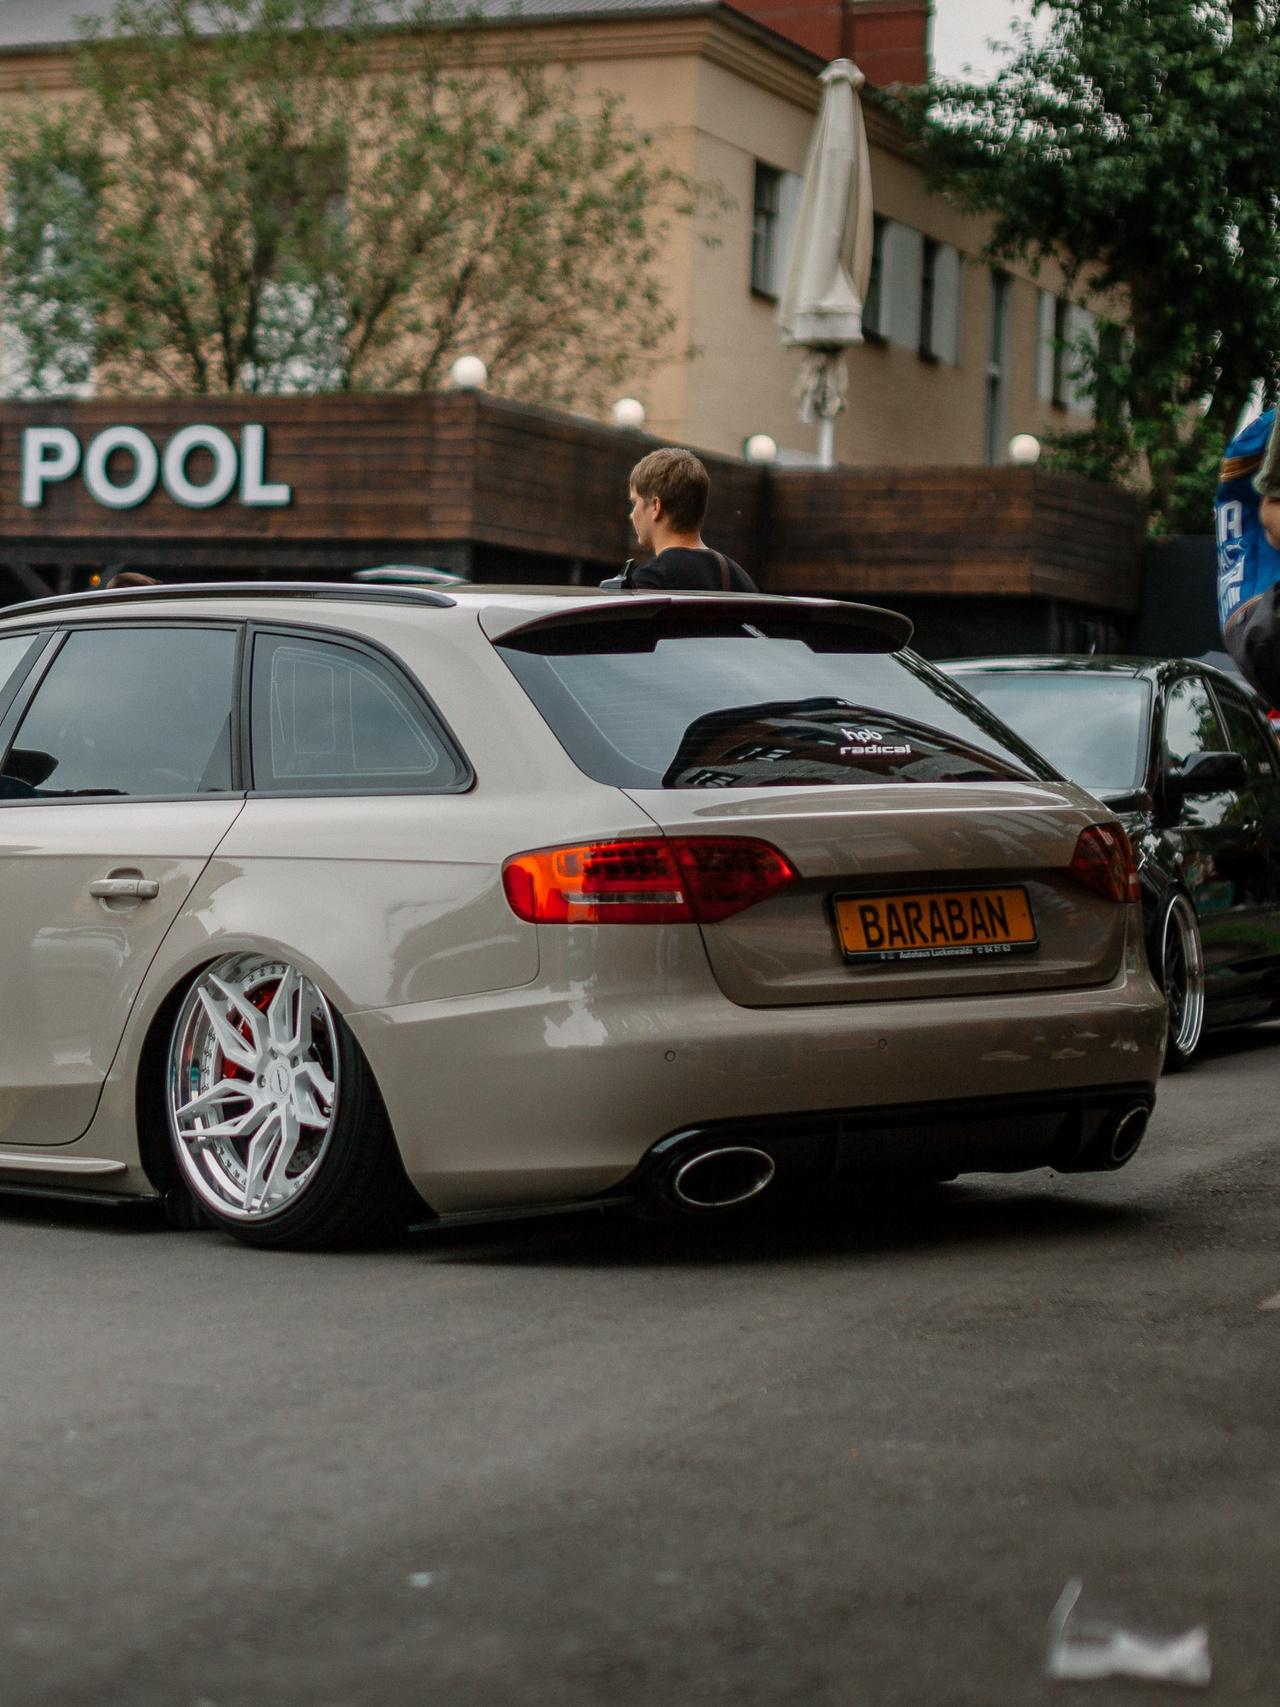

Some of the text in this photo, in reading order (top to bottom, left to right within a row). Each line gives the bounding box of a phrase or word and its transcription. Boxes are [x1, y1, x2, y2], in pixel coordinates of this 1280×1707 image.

[20, 424, 291, 509] POOL
[840, 728, 883, 743] hpb
[840, 744, 911, 754] radical
[858, 896, 1010, 947] BARABAN
